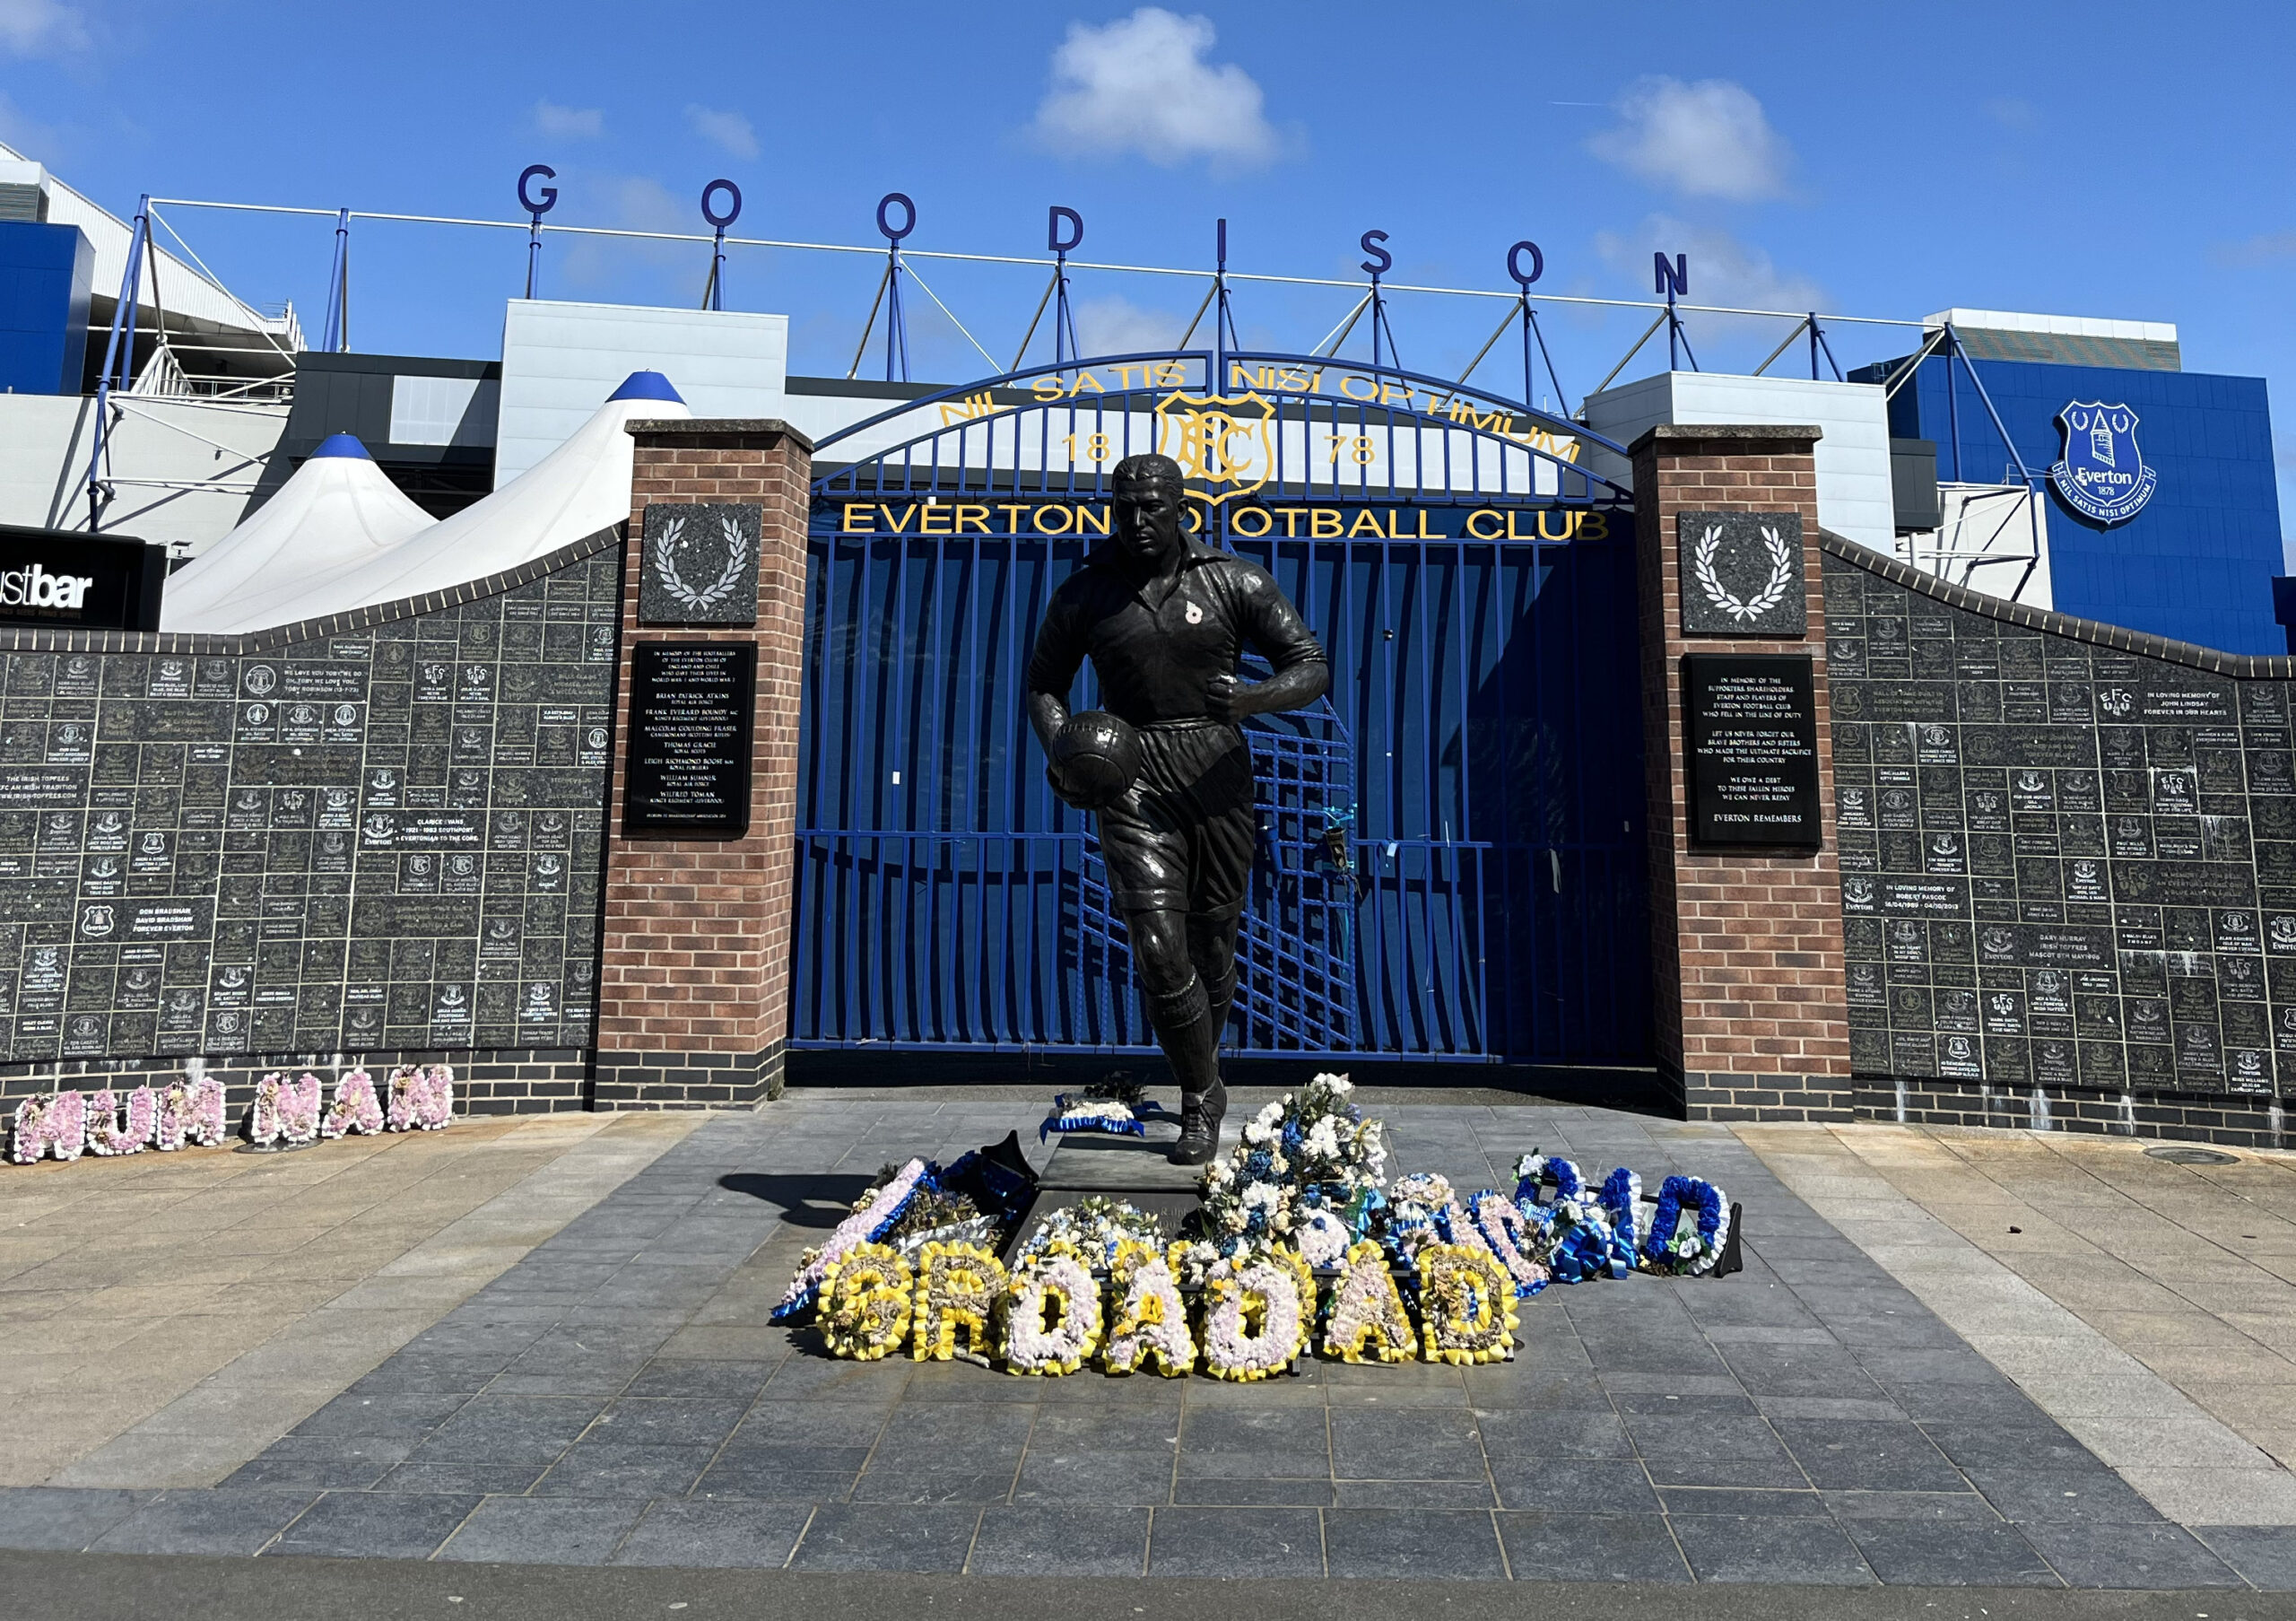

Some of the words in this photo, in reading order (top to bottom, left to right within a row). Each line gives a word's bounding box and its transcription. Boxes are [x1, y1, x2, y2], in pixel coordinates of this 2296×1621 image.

[517, 164, 1688, 295] GOODISON
[939, 391, 1013, 426] NIL
[1031, 362, 1186, 402] SATIS
[1231, 365, 1321, 394] NISI
[1340, 375, 1581, 464] OPTIMUM
[1063, 432, 1110, 463] 18
[1324, 435, 1375, 466] 78
[2077, 467, 2132, 485] Everton
[2097, 486, 2115, 495] 1878
[2060, 479, 2072, 497] NIL
[2074, 496, 2096, 514] SATIS
[2099, 509, 2118, 517] NISI
[2120, 484, 2152, 514] OPTIMUM
[843, 503, 1110, 536] EVERTON
[1188, 506, 1447, 539] OTBALL
[1466, 509, 1608, 540] CLUB
[2100, 689, 2132, 702] EFC
[1754, 815, 1802, 823] REMEMBERS
